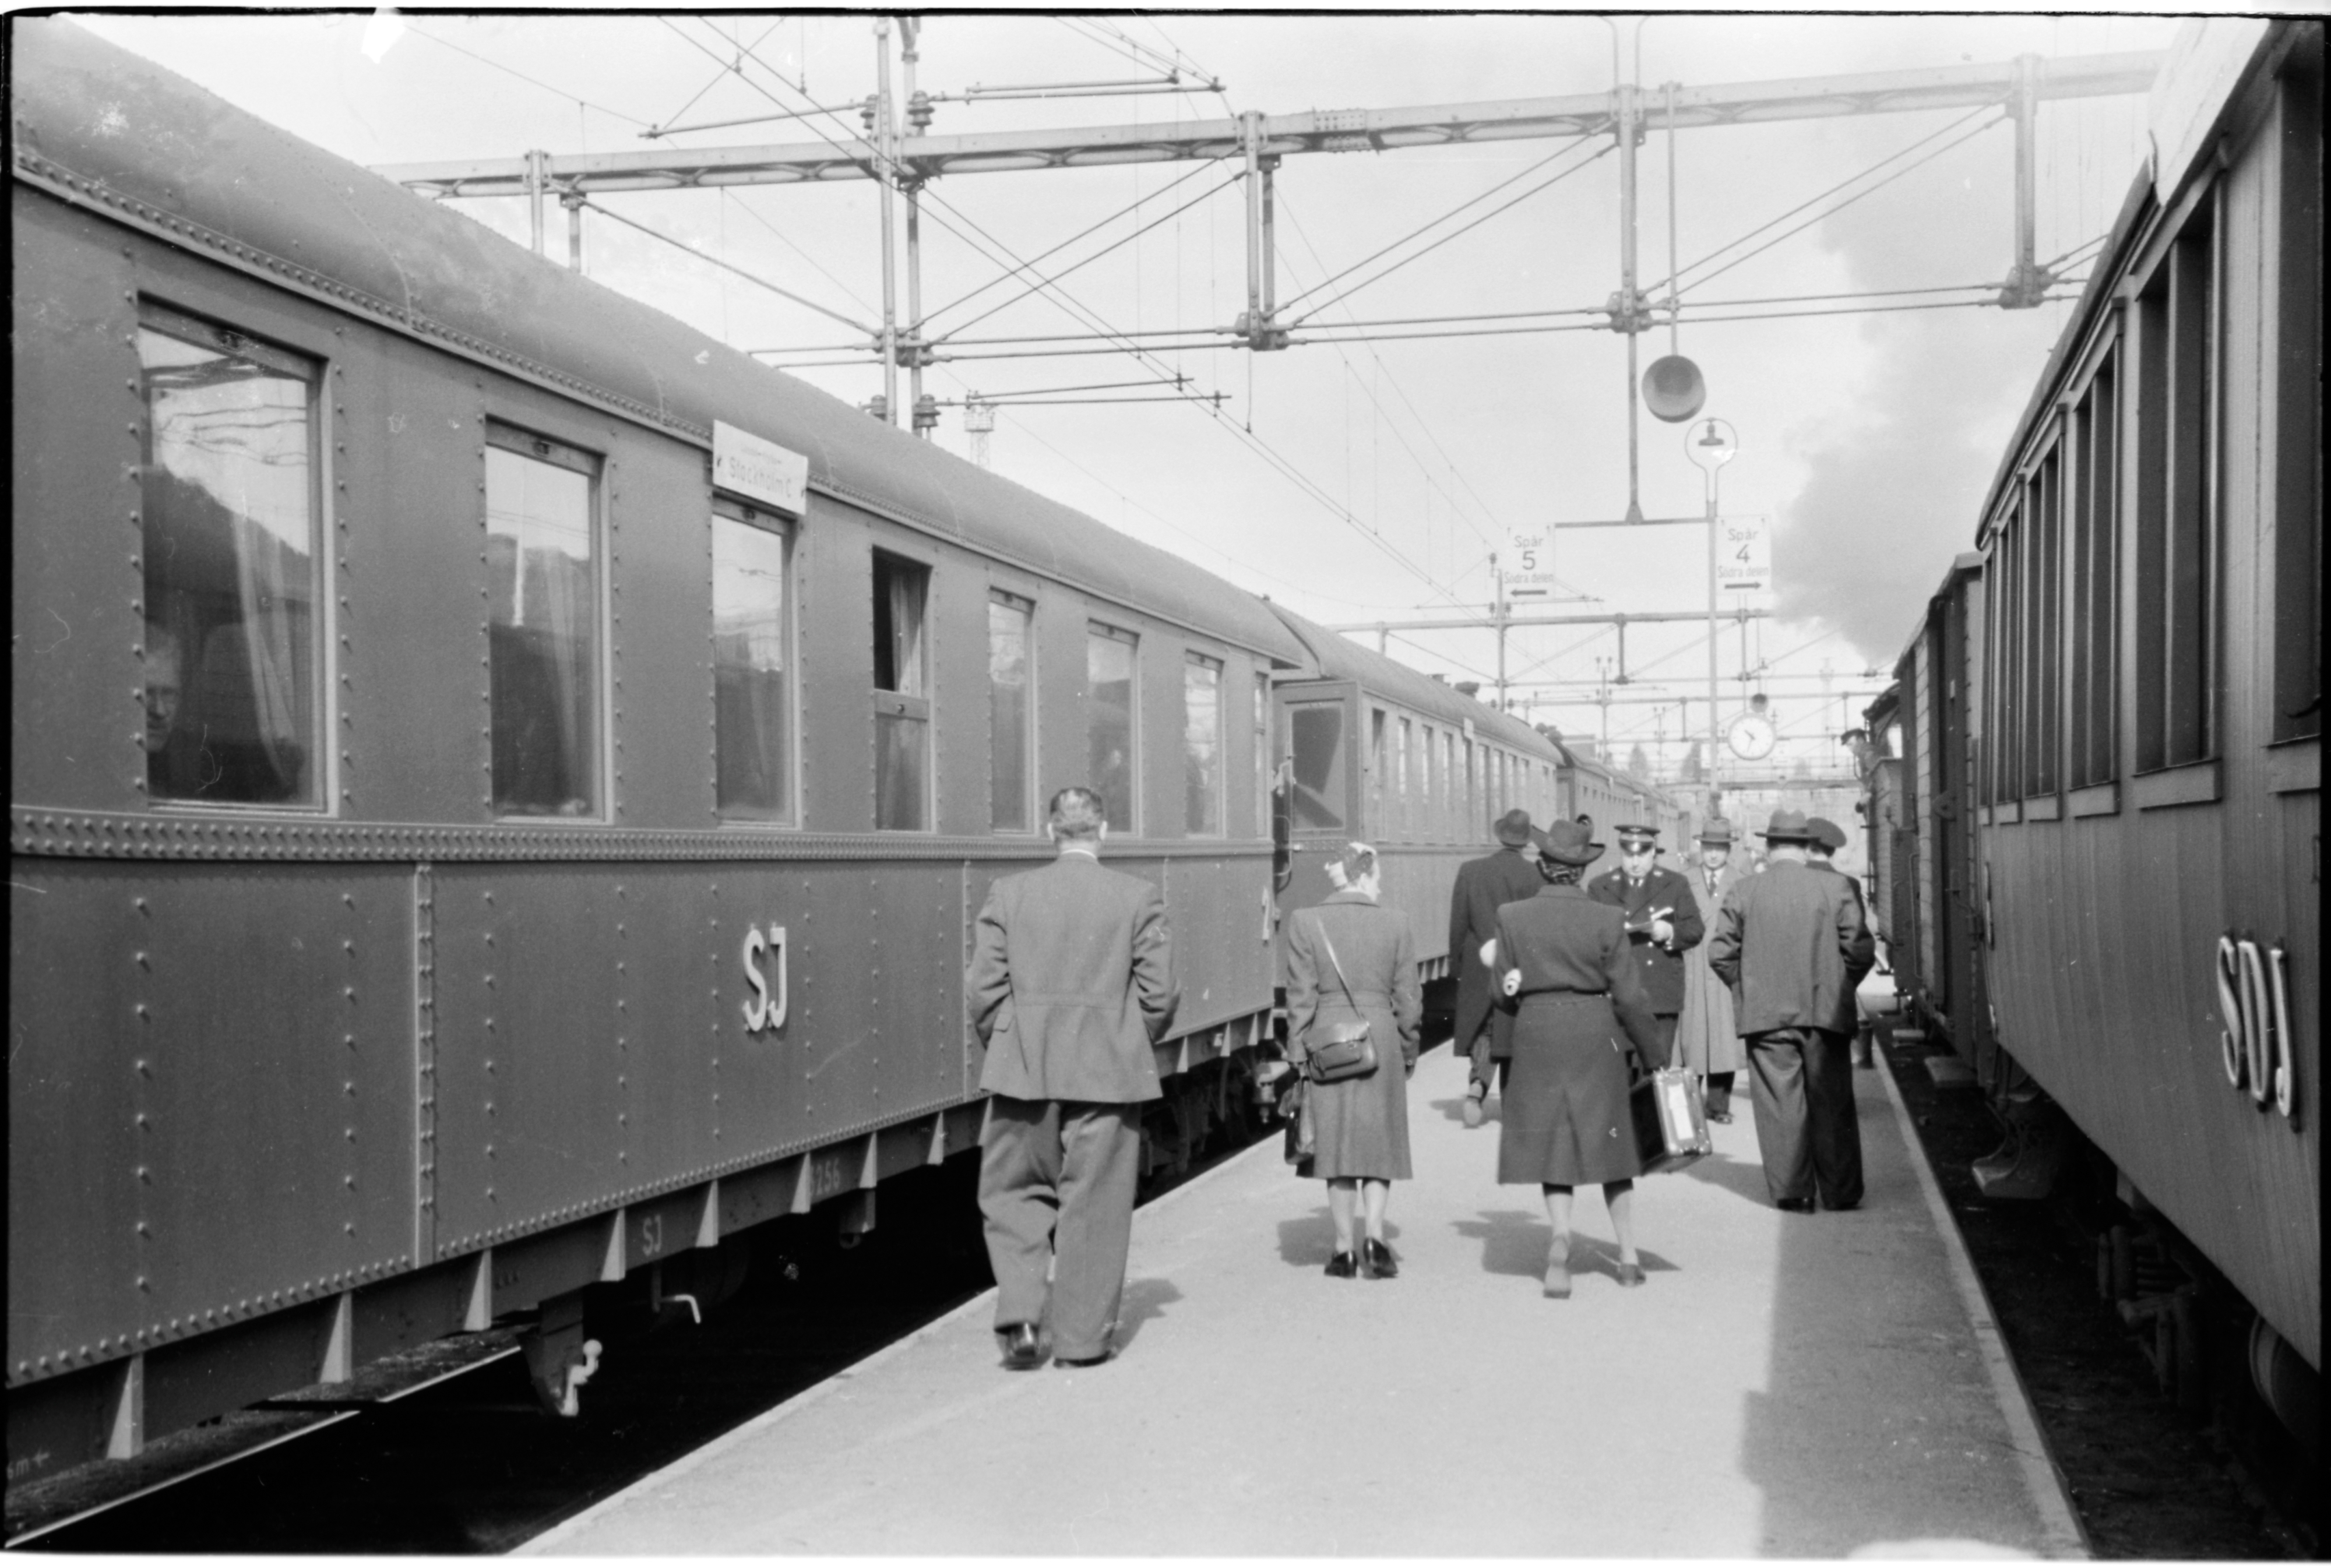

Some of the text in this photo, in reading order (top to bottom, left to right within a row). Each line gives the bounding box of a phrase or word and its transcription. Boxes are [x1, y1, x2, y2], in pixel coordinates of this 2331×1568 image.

[1515, 535, 1544, 549] Spår
[1728, 528, 1759, 542] Spår
[1522, 551, 1536, 570] 5
[1736, 544, 1750, 563] 4
[742, 925, 787, 1031] SJ
[643, 1213, 662, 1257] SJ
